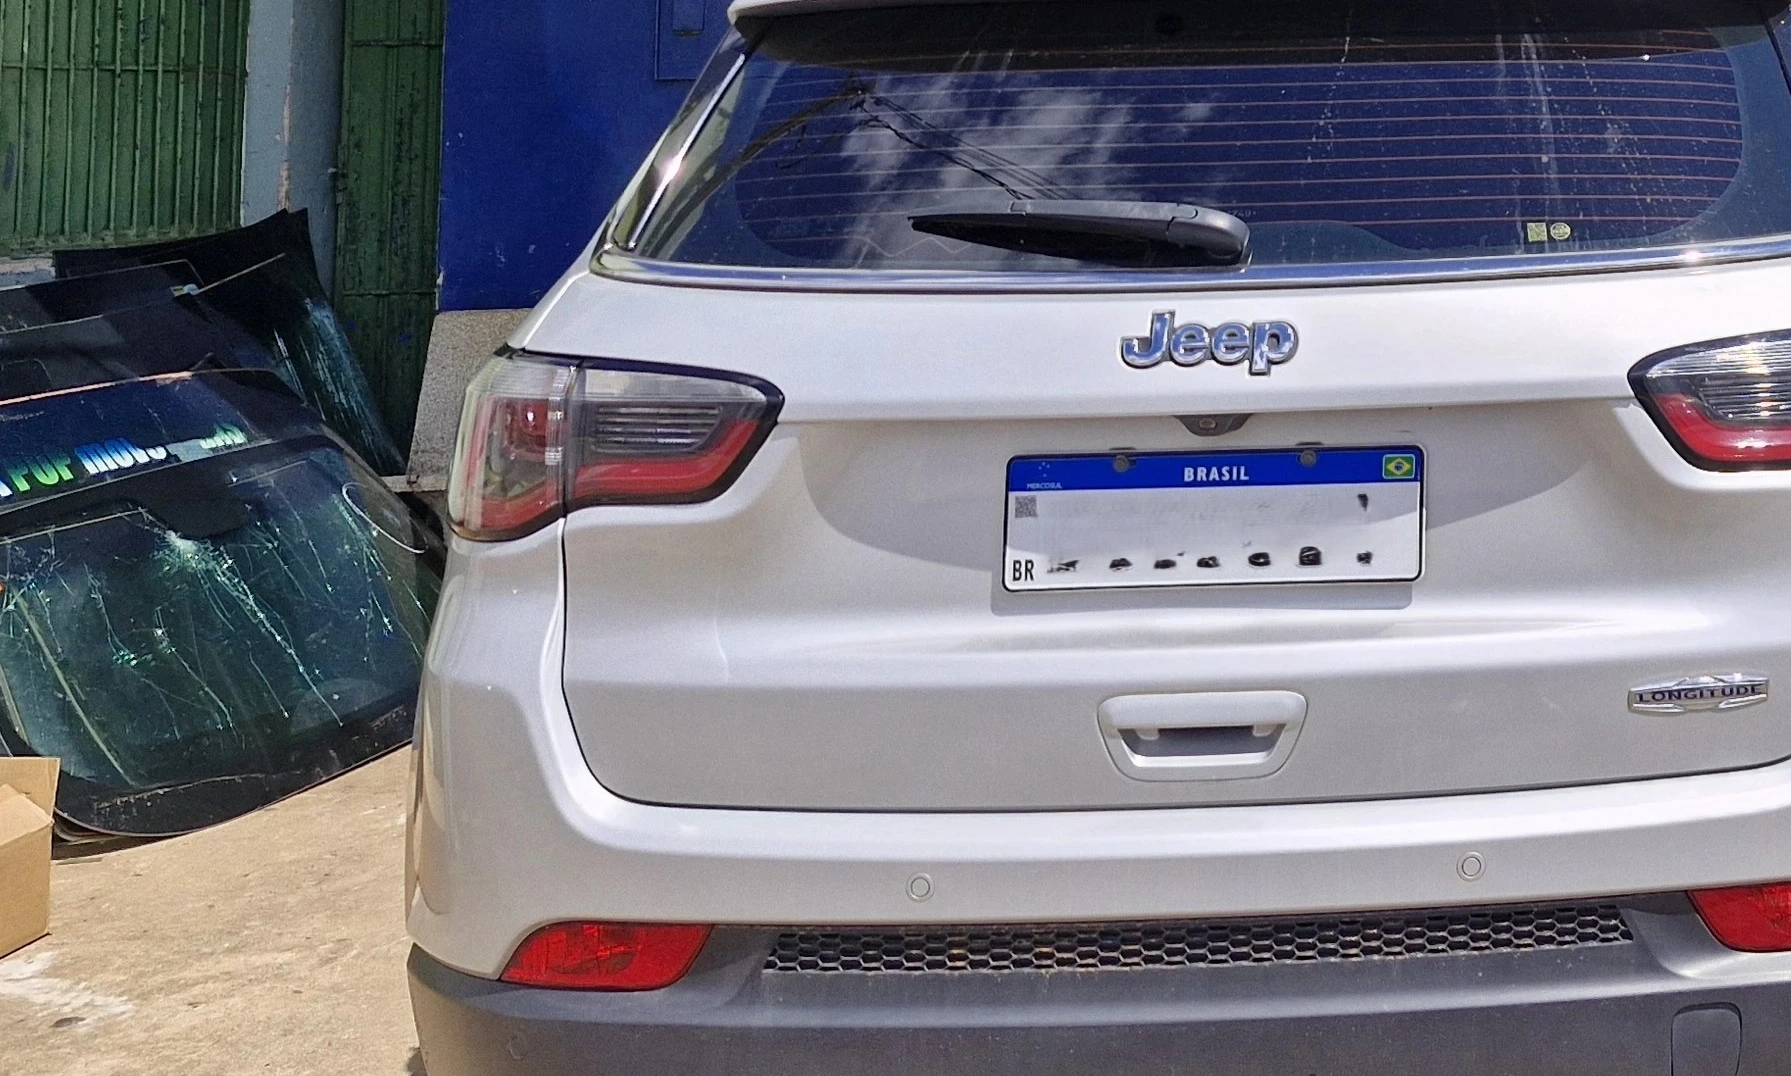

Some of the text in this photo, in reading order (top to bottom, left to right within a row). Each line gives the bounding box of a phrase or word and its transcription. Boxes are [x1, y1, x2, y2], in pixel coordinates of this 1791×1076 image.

[1120, 308, 1299, 377] Jeep
[1183, 464, 1250, 483] BRASIL
[1012, 558, 1035, 583] BR
[1638, 683, 1763, 703] LONGITUDE
